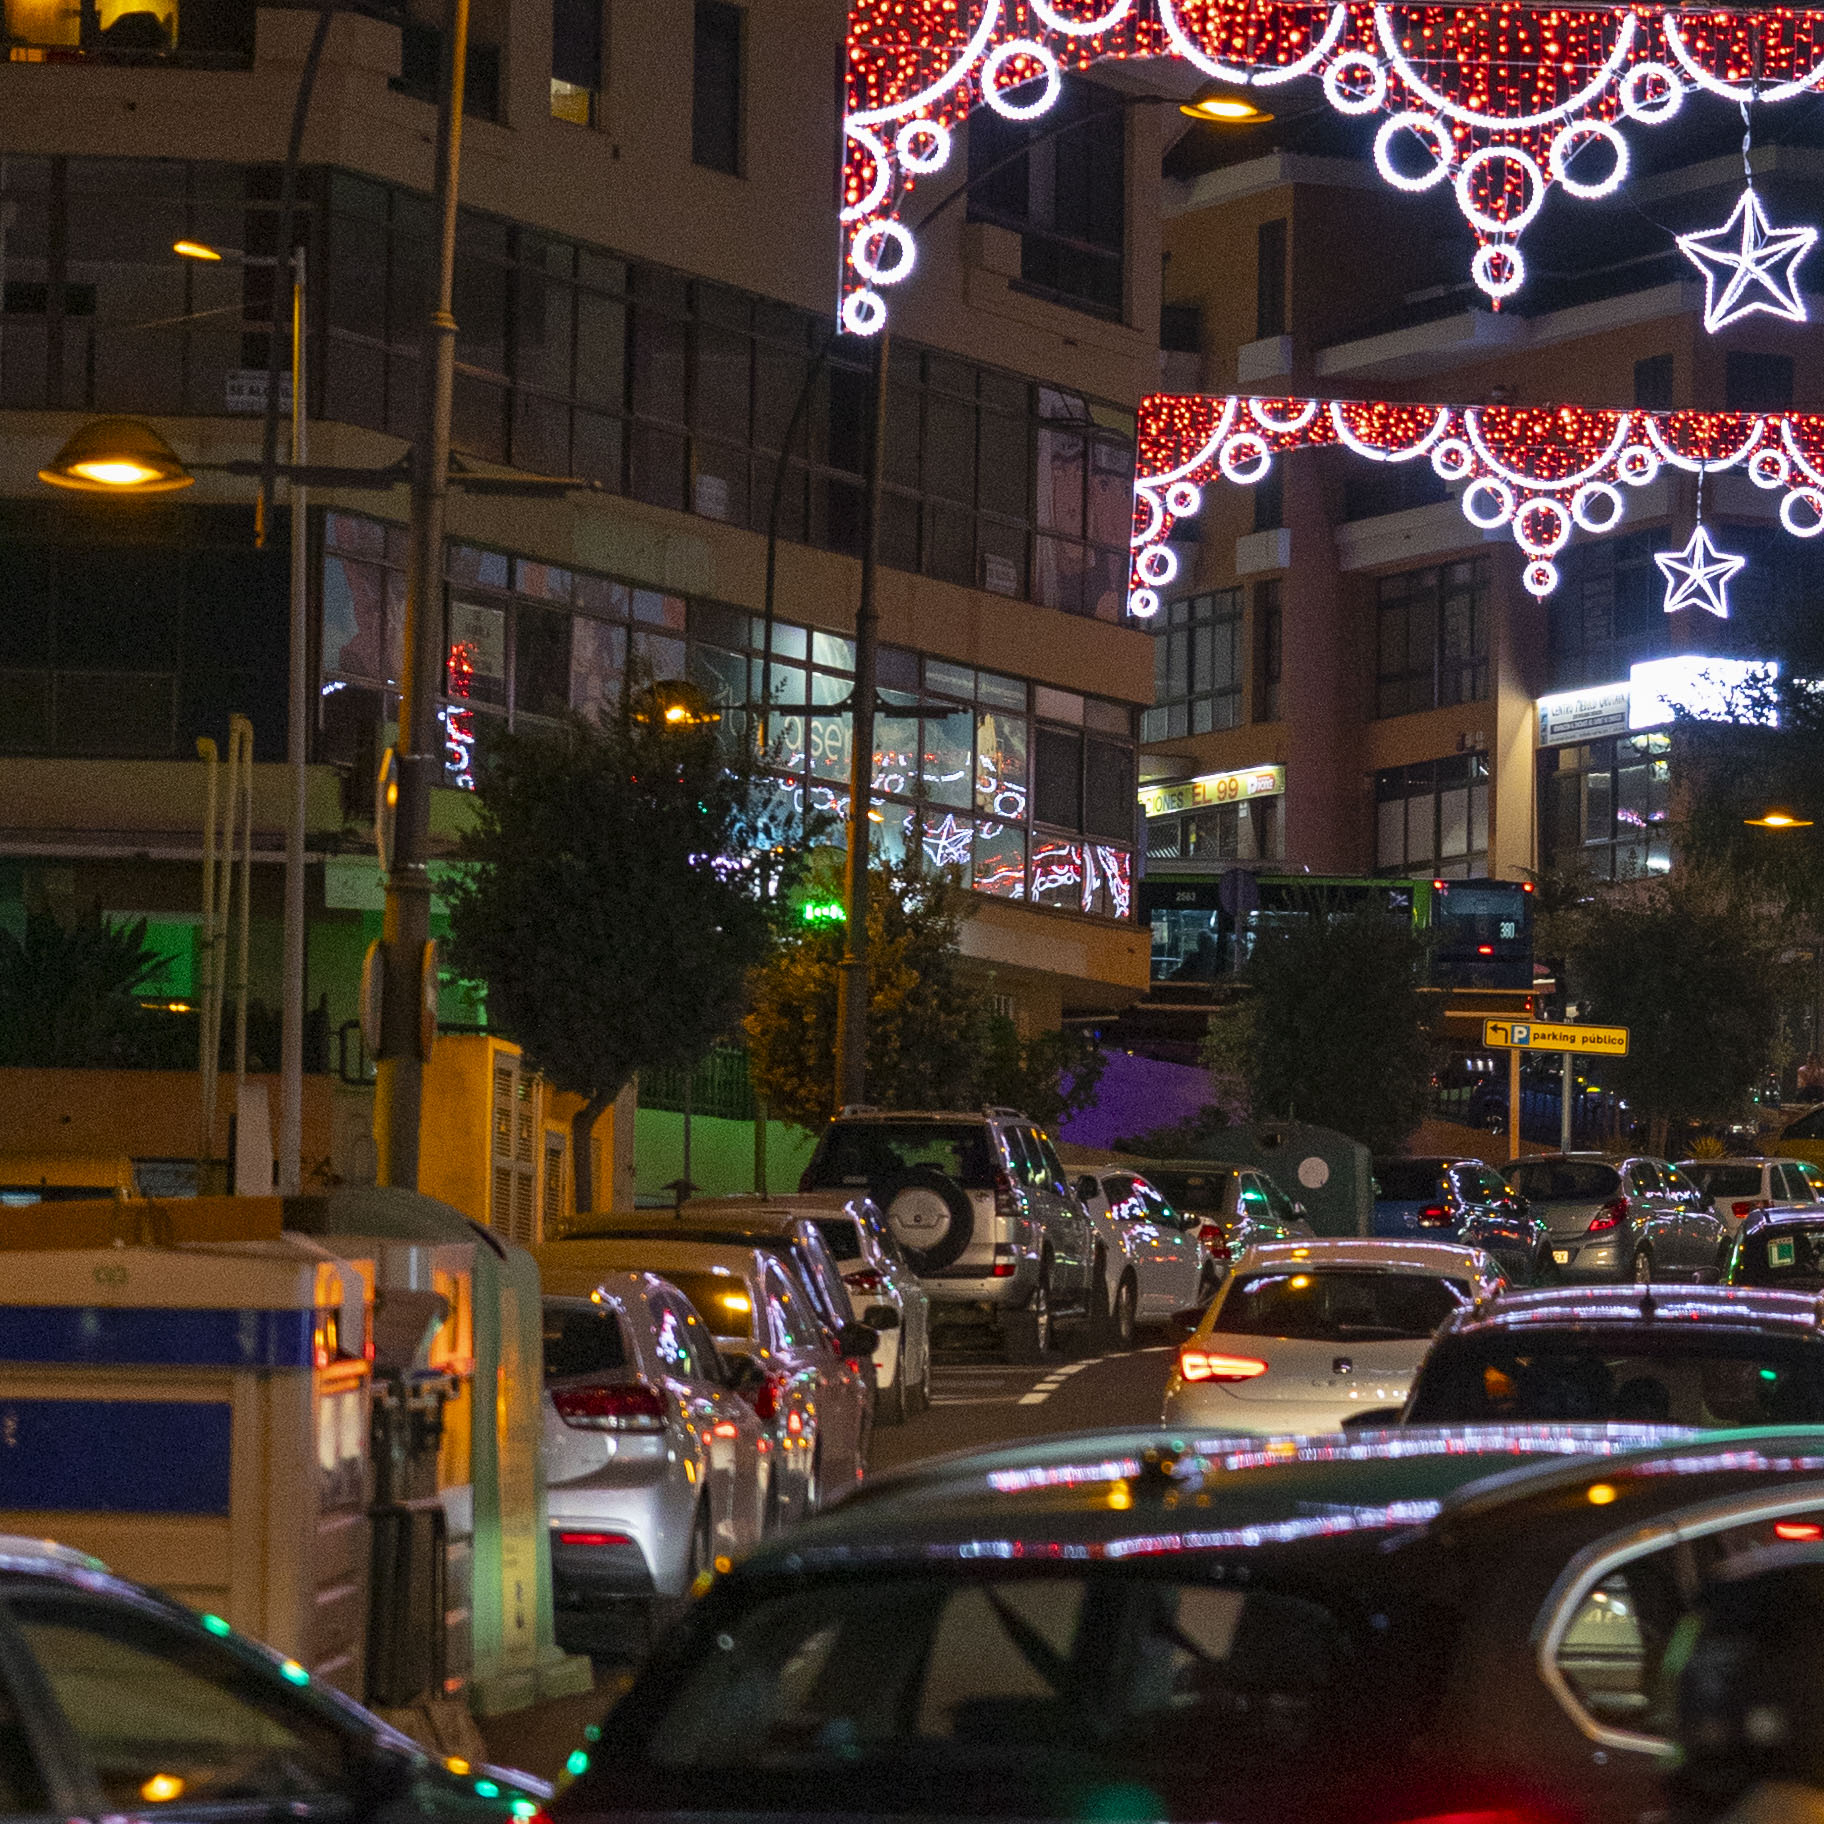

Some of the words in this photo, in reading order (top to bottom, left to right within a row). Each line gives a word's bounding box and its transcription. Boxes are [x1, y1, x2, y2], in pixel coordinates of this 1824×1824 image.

[1192, 783, 1212, 805] EL
[1217, 778, 1238, 801] 99
[1499, 921, 1515, 939] 380
[1533, 1033, 1576, 1043] parking
